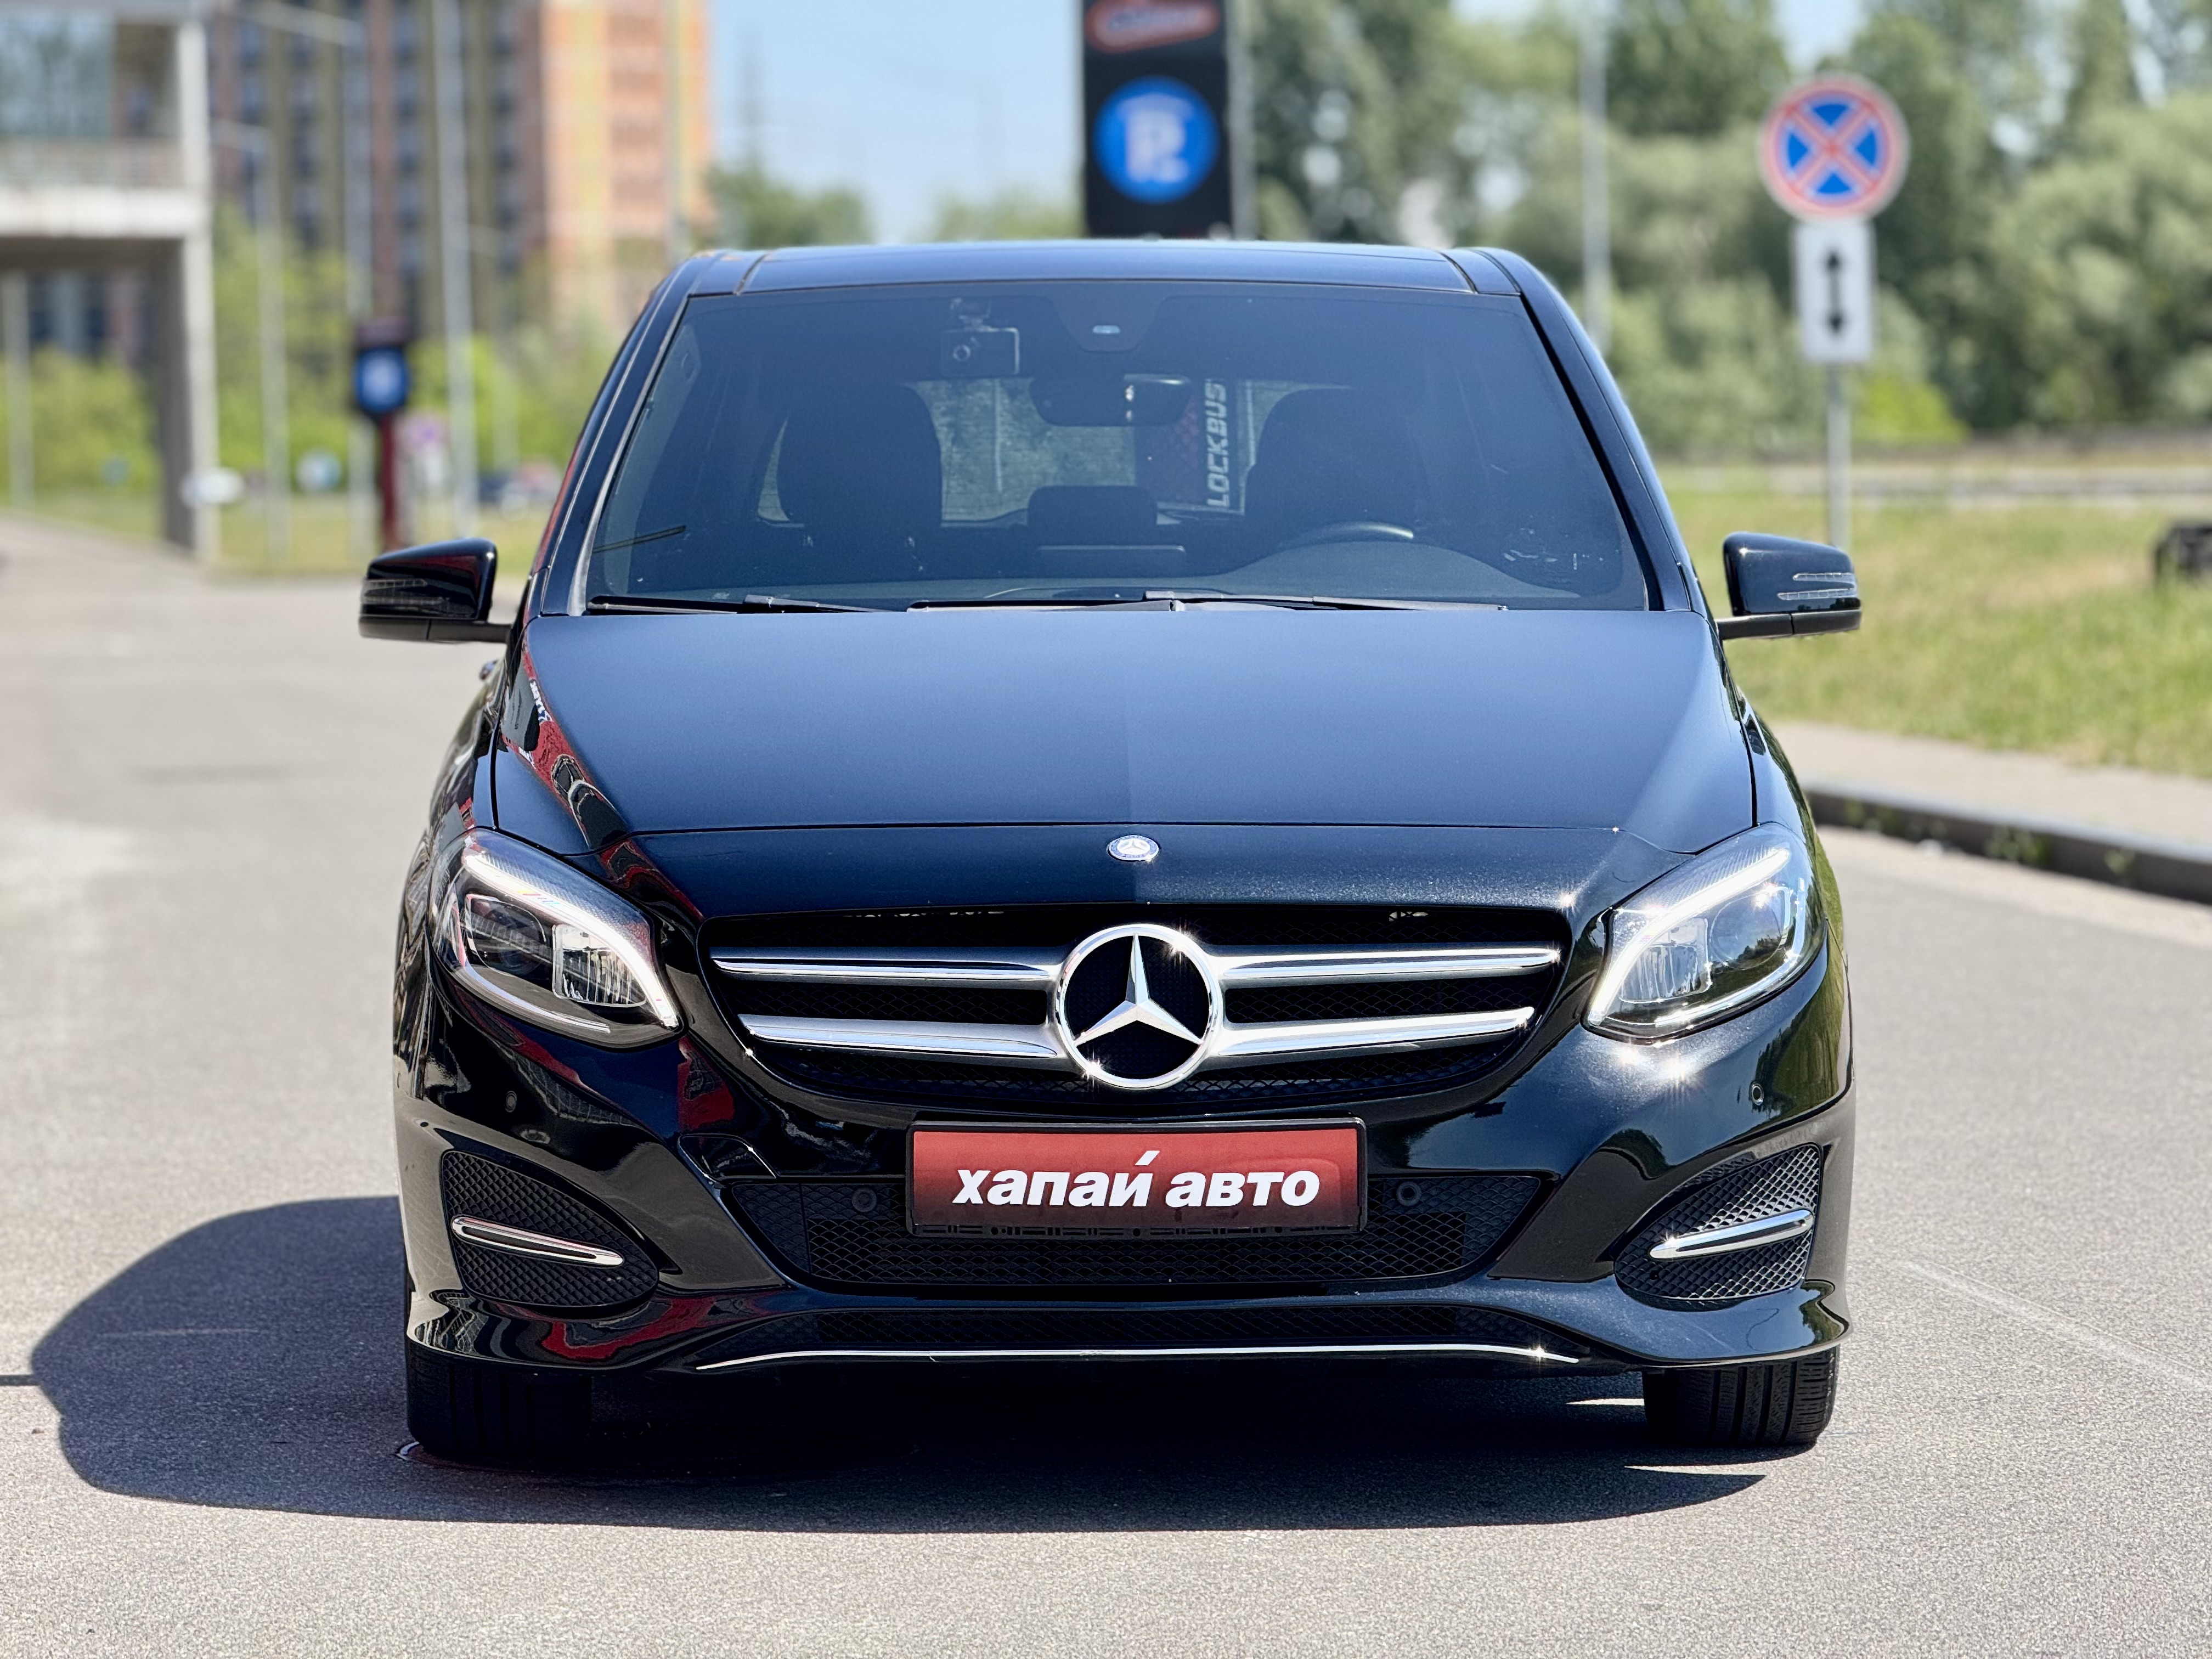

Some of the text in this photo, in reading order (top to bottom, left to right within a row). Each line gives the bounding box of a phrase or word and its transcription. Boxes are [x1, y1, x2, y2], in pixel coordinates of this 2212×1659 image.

[1205, 379, 1229, 507] LOCKBUS
[952, 1150, 1321, 1207] хапай авто
